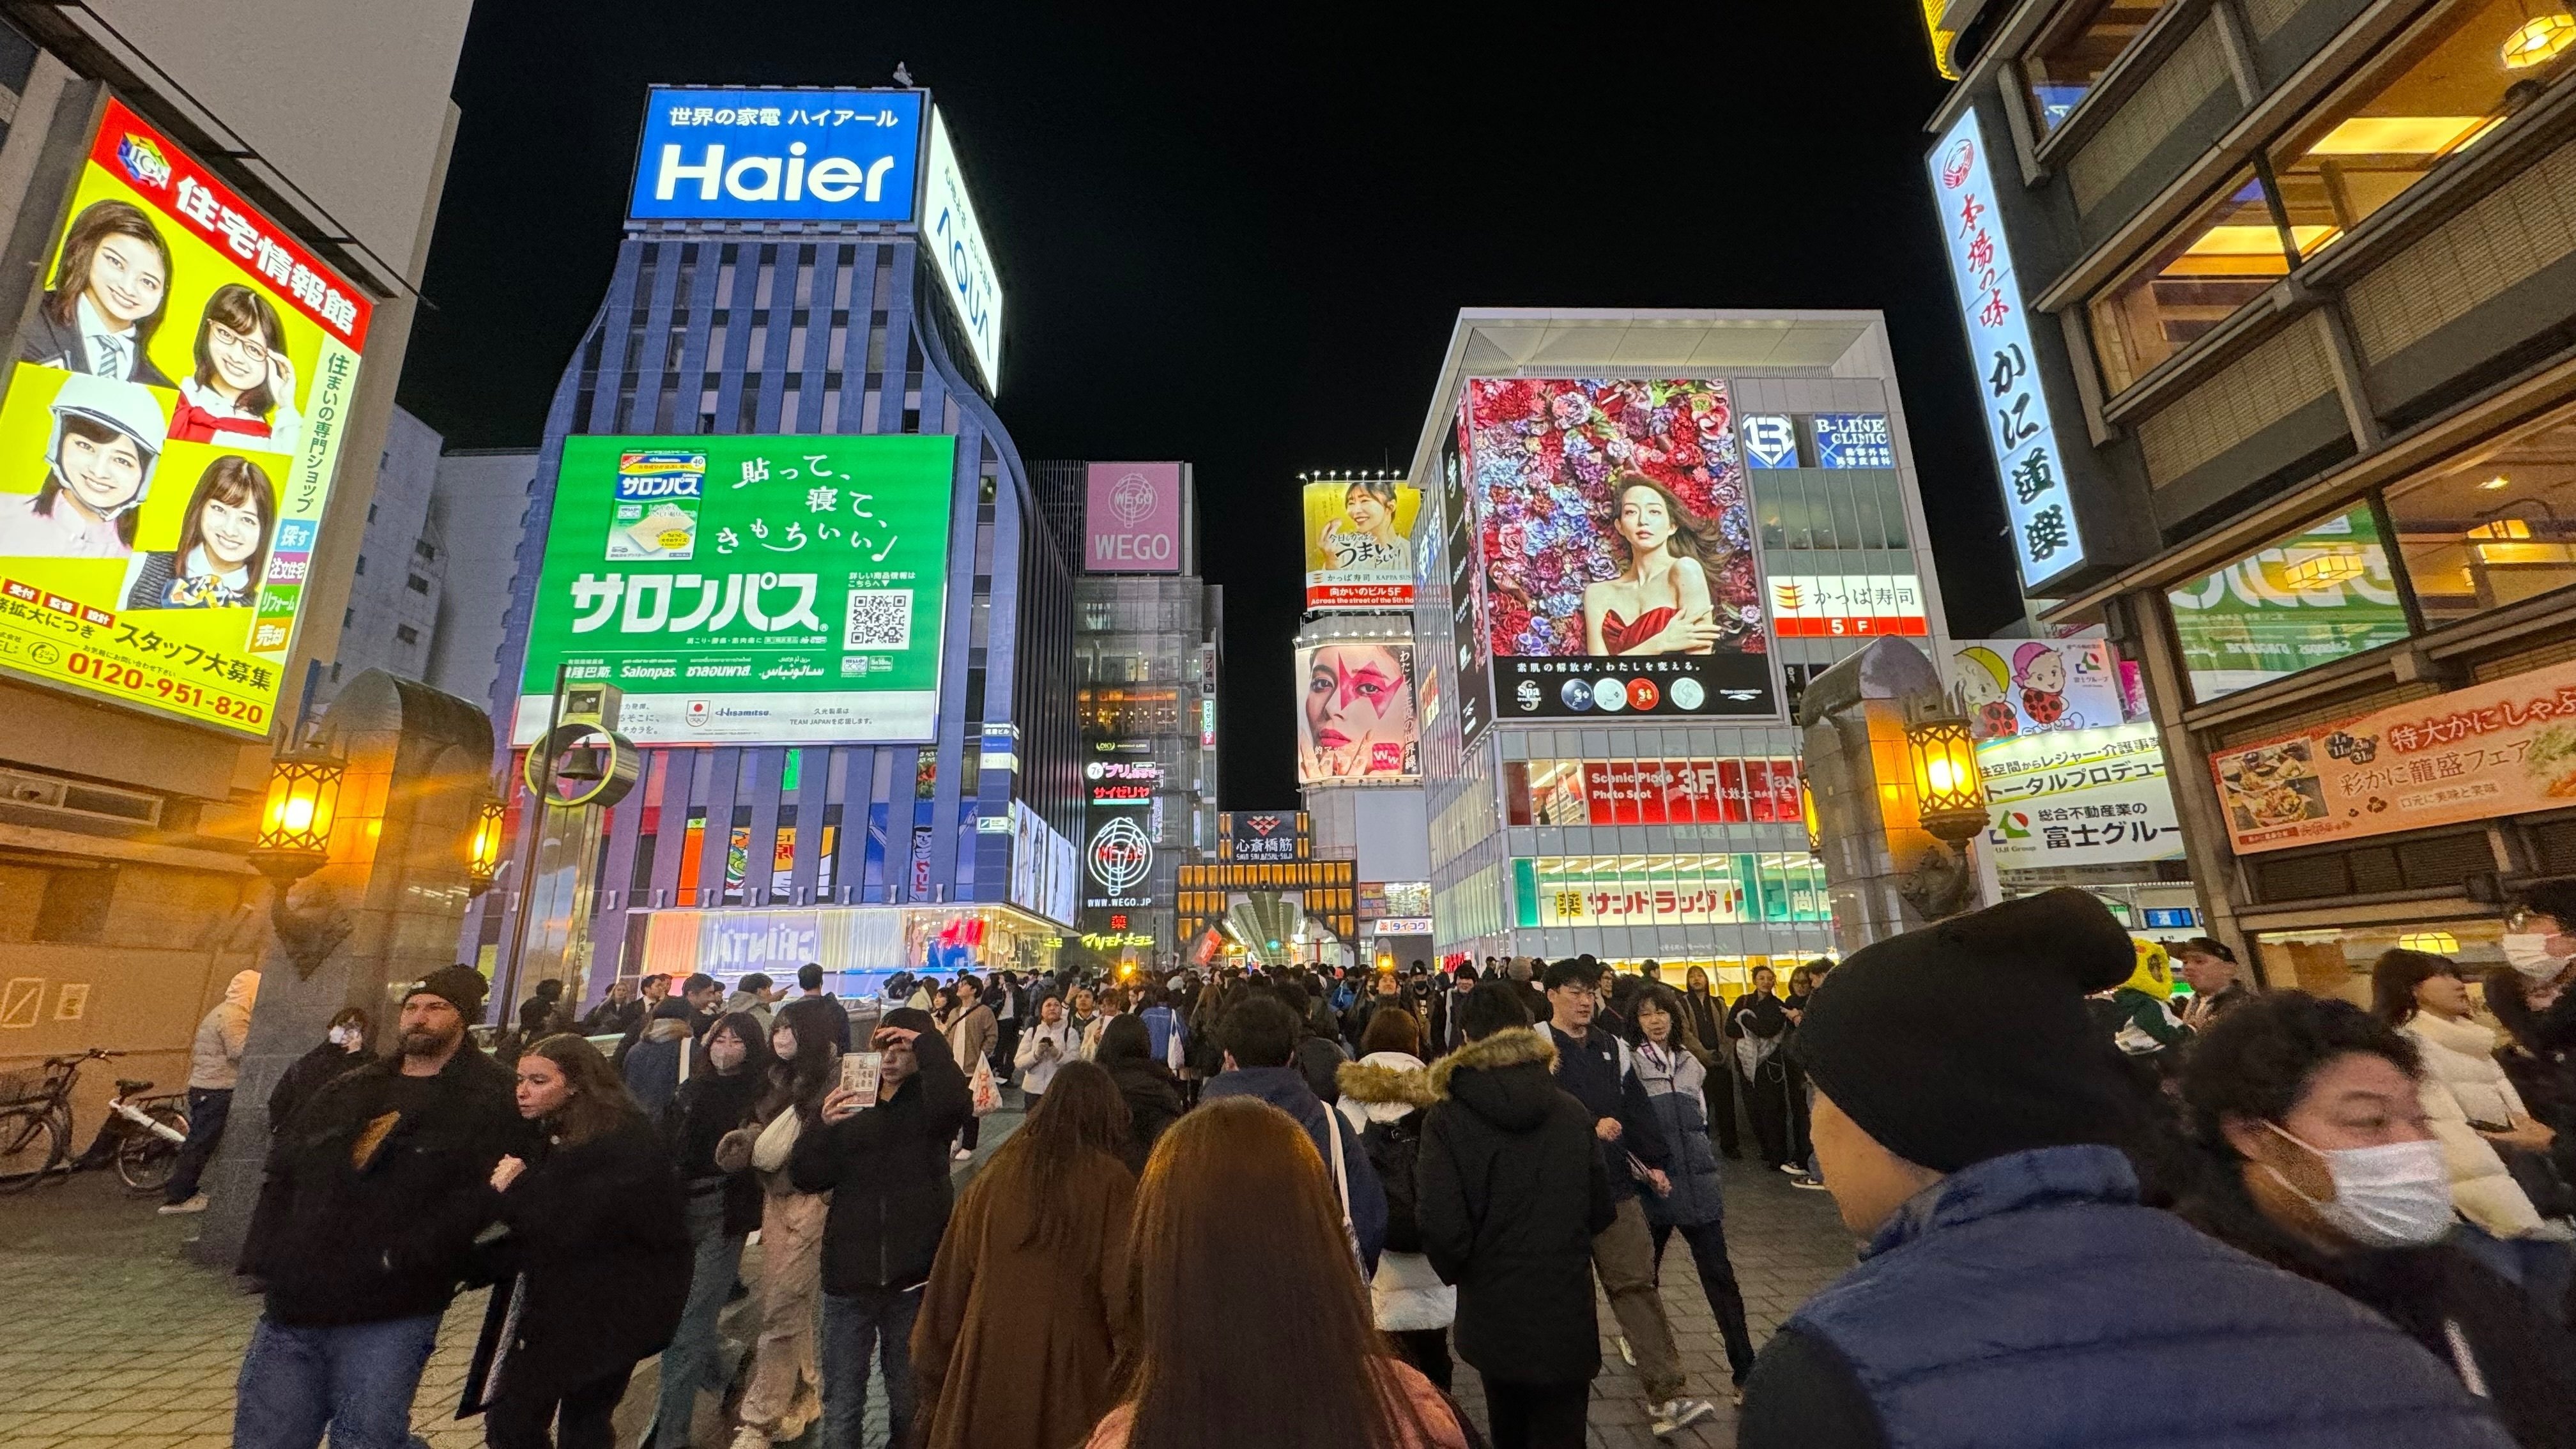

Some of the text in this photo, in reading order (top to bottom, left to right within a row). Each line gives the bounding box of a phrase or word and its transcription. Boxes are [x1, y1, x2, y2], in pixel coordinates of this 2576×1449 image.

[670, 107, 898, 128] 世界の家電 ハイアール
[656, 142, 894, 202] Haier
[174, 176, 357, 337] 住宅情報館
[1959, 193, 2010, 328] 本場の味
[296, 352, 349, 513] 住まいの専門ショップ
[1816, 419, 1885, 433] B-LINE
[1831, 434, 1887, 444] CLINIC
[1989, 342, 2068, 564] かに道楽
[732, 454, 851, 489] 貼って、
[622, 477, 699, 496] サロンパス
[806, 487, 887, 528] 寝て、
[280, 525, 310, 546] 探す
[1094, 533, 1170, 560] WEGO
[1335, 542, 1393, 568] うまい
[268, 557, 306, 581] 注文住宅
[1327, 574, 1370, 582] かっぱ寿司
[1330, 587, 1401, 596] 向かいのビル5F
[1813, 588, 1915, 606] かっぱ寿司
[261, 592, 296, 614] リフォーム
[571, 572, 819, 634] サロンパス
[255, 624, 286, 648] 売却
[82, 645, 177, 677] お気軽にお問い合わせ下さい
[114, 622, 273, 692] スタッフ大募集
[1517, 663, 1701, 673] 素肌の解放が、わたしを変える。
[620, 665, 675, 680] Salonpas
[67, 652, 263, 724] 0120-951-820
[1517, 686, 1540, 699] Spa
[2340, 739, 2531, 796] 彩かに籠盛フェア
[1591, 772, 1634, 783] Scenic
[1678, 769, 1715, 793] 3F
[1093, 786, 1150, 799] サイゼリヤ
[1593, 790, 1652, 800] Photo Spot
[2038, 802, 2147, 822] 総合不動産業の
[1236, 838, 1292, 852] 心斎橋筋
[1087, 898, 1151, 907] WWW.WEGO.JP
[1559, 889, 1717, 915] 薬 サンドラッグ
[1111, 915, 1127, 929] 薬
[1082, 932, 1154, 951] マツモトキヨシ
